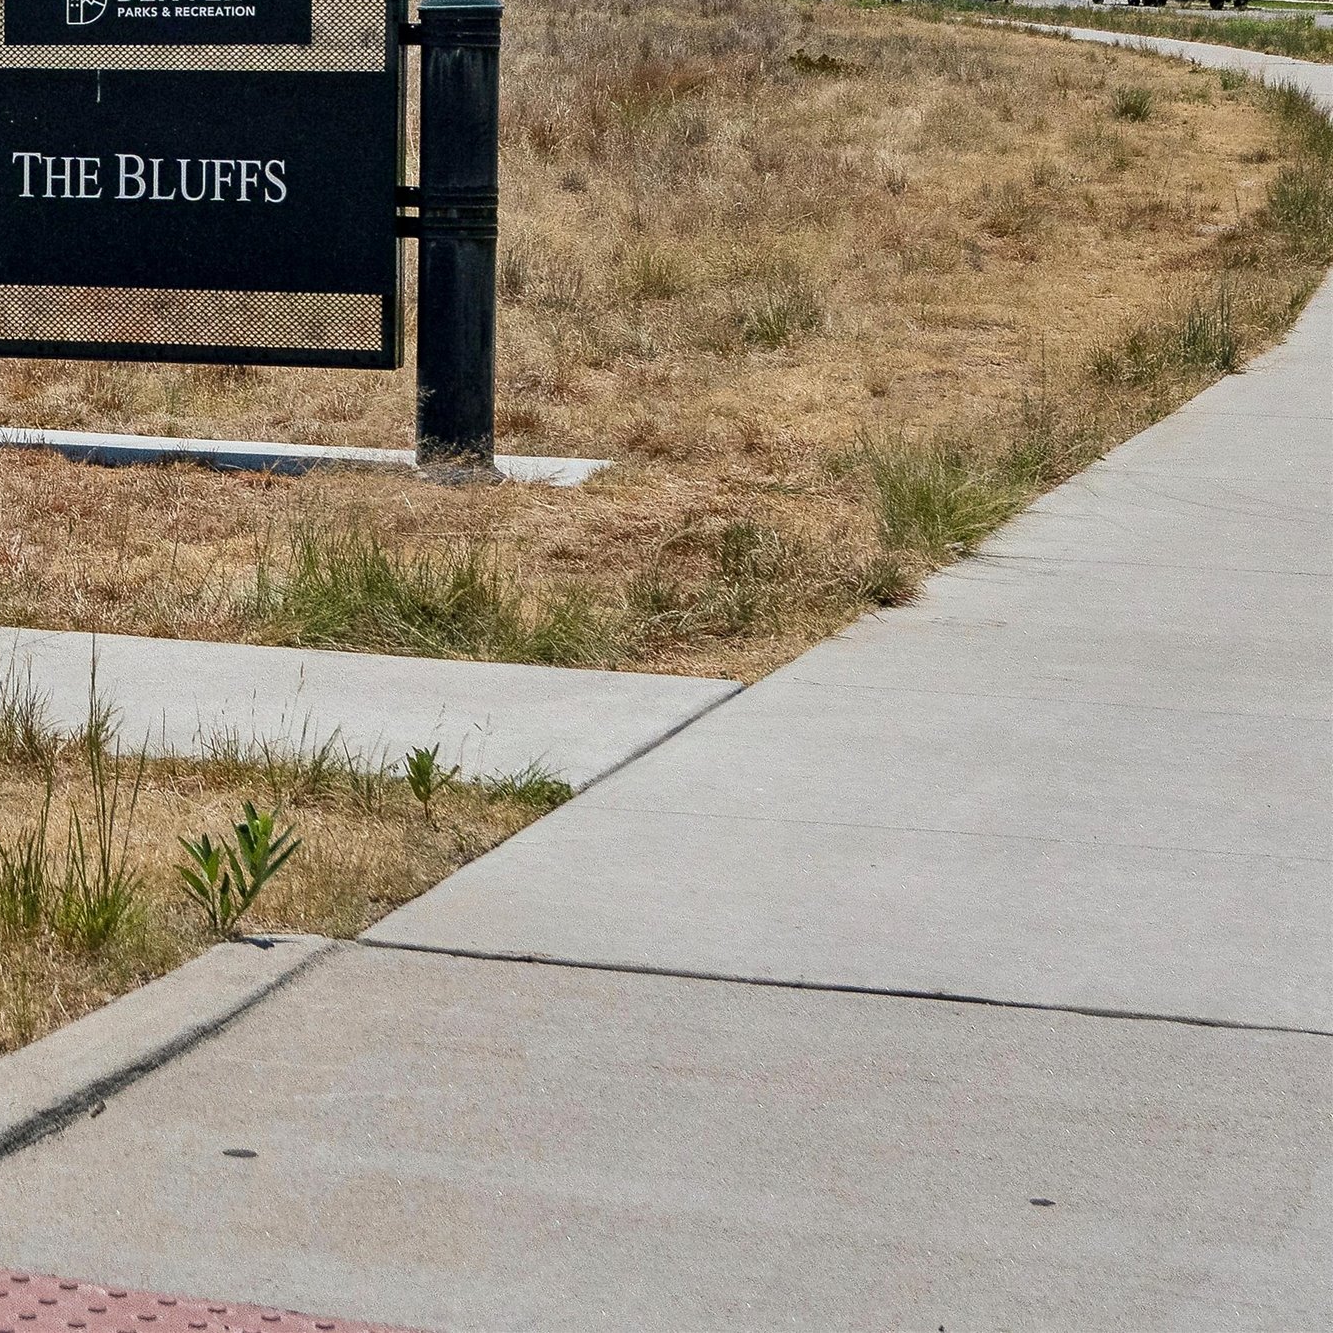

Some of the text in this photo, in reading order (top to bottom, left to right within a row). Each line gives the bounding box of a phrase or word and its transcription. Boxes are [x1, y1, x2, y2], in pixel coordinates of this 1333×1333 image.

[117, 6, 256, 18] PARKS & RECREATION
